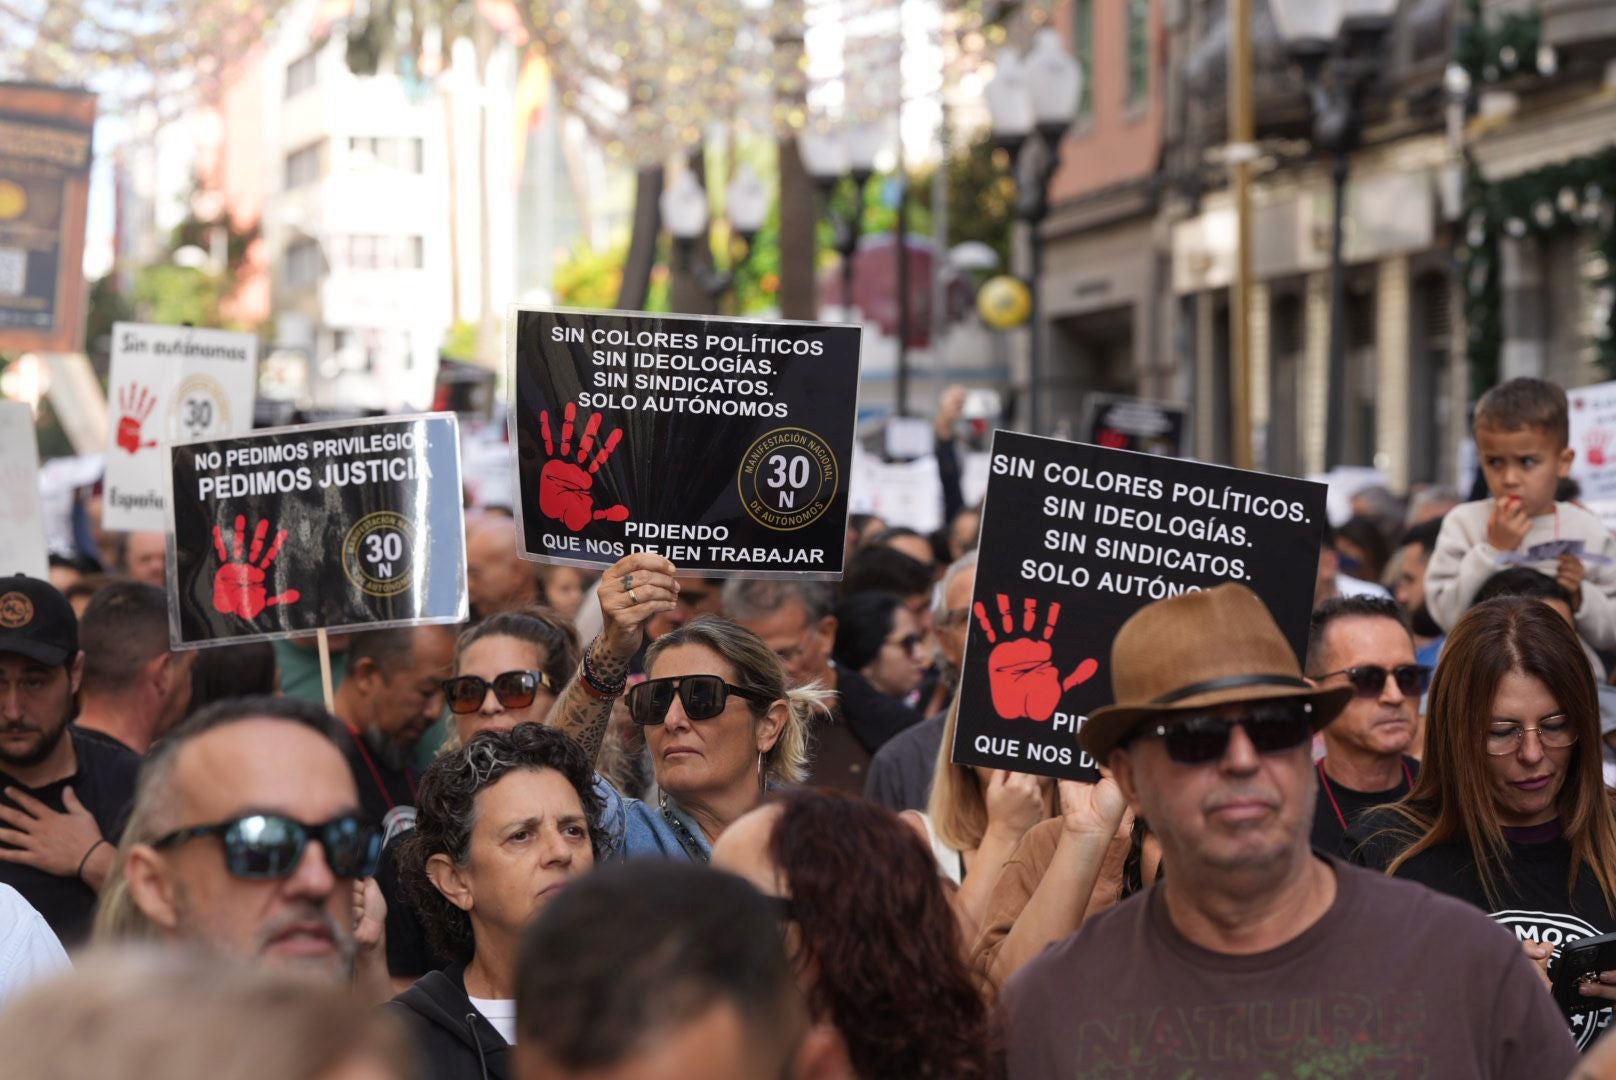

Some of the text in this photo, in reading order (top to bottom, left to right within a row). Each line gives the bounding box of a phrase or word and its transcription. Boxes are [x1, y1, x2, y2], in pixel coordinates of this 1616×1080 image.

[551, 326, 824, 356] SIN COLORES POLÍTICOS
[591, 350, 778, 375] SIN IDEOLOGÍAS.
[593, 371, 774, 396] SIN SINDICATOS.
[577, 391, 789, 418] SOLO AUTÓNOMOS
[194, 451, 222, 471] NO
[225, 442, 309, 468] PEDIMOS
[744, 432, 833, 482] MANIFESTACIÓN NACIONAL
[767, 454, 811, 489] 30
[198, 466, 313, 501] PEDIMOS
[992, 453, 1312, 524] SIN COLORES POLÍTICOS.
[750, 500, 824, 526] DE AUTÓNOMOS
[778, 490, 795, 509] N
[624, 521, 729, 541] PIDIENDO
[1042, 495, 1254, 548] SIN IDEOLOGÍAS.
[365, 532, 403, 563] 30
[542, 533, 581, 552] QUE
[585, 538, 625, 557] NOS
[707, 546, 825, 564] TRABAJAR
[1043, 529, 1252, 581] SIN SINDICATOS.
[377, 562, 393, 578] N
[1020, 558, 1090, 587] SOLO
[974, 735, 1020, 758] QUE
[1026, 742, 1073, 765] NOS
